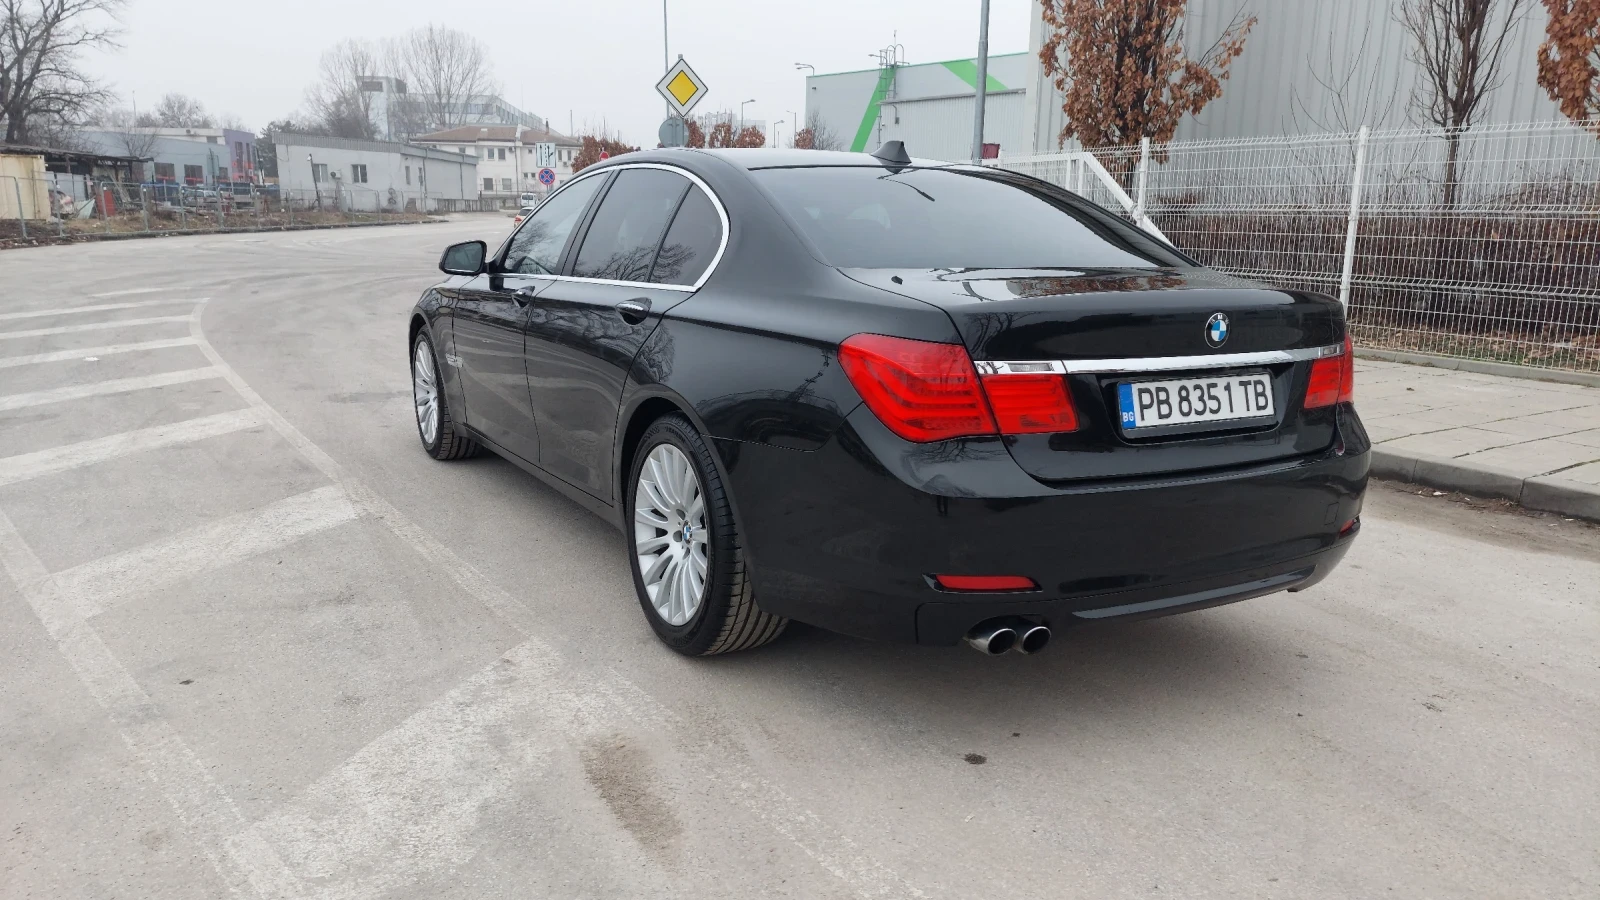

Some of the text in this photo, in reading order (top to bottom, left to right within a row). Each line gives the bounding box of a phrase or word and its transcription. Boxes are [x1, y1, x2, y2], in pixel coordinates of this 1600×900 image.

[1137, 379, 1269, 422] PB 8351 TB
[1122, 411, 1134, 422] BG
